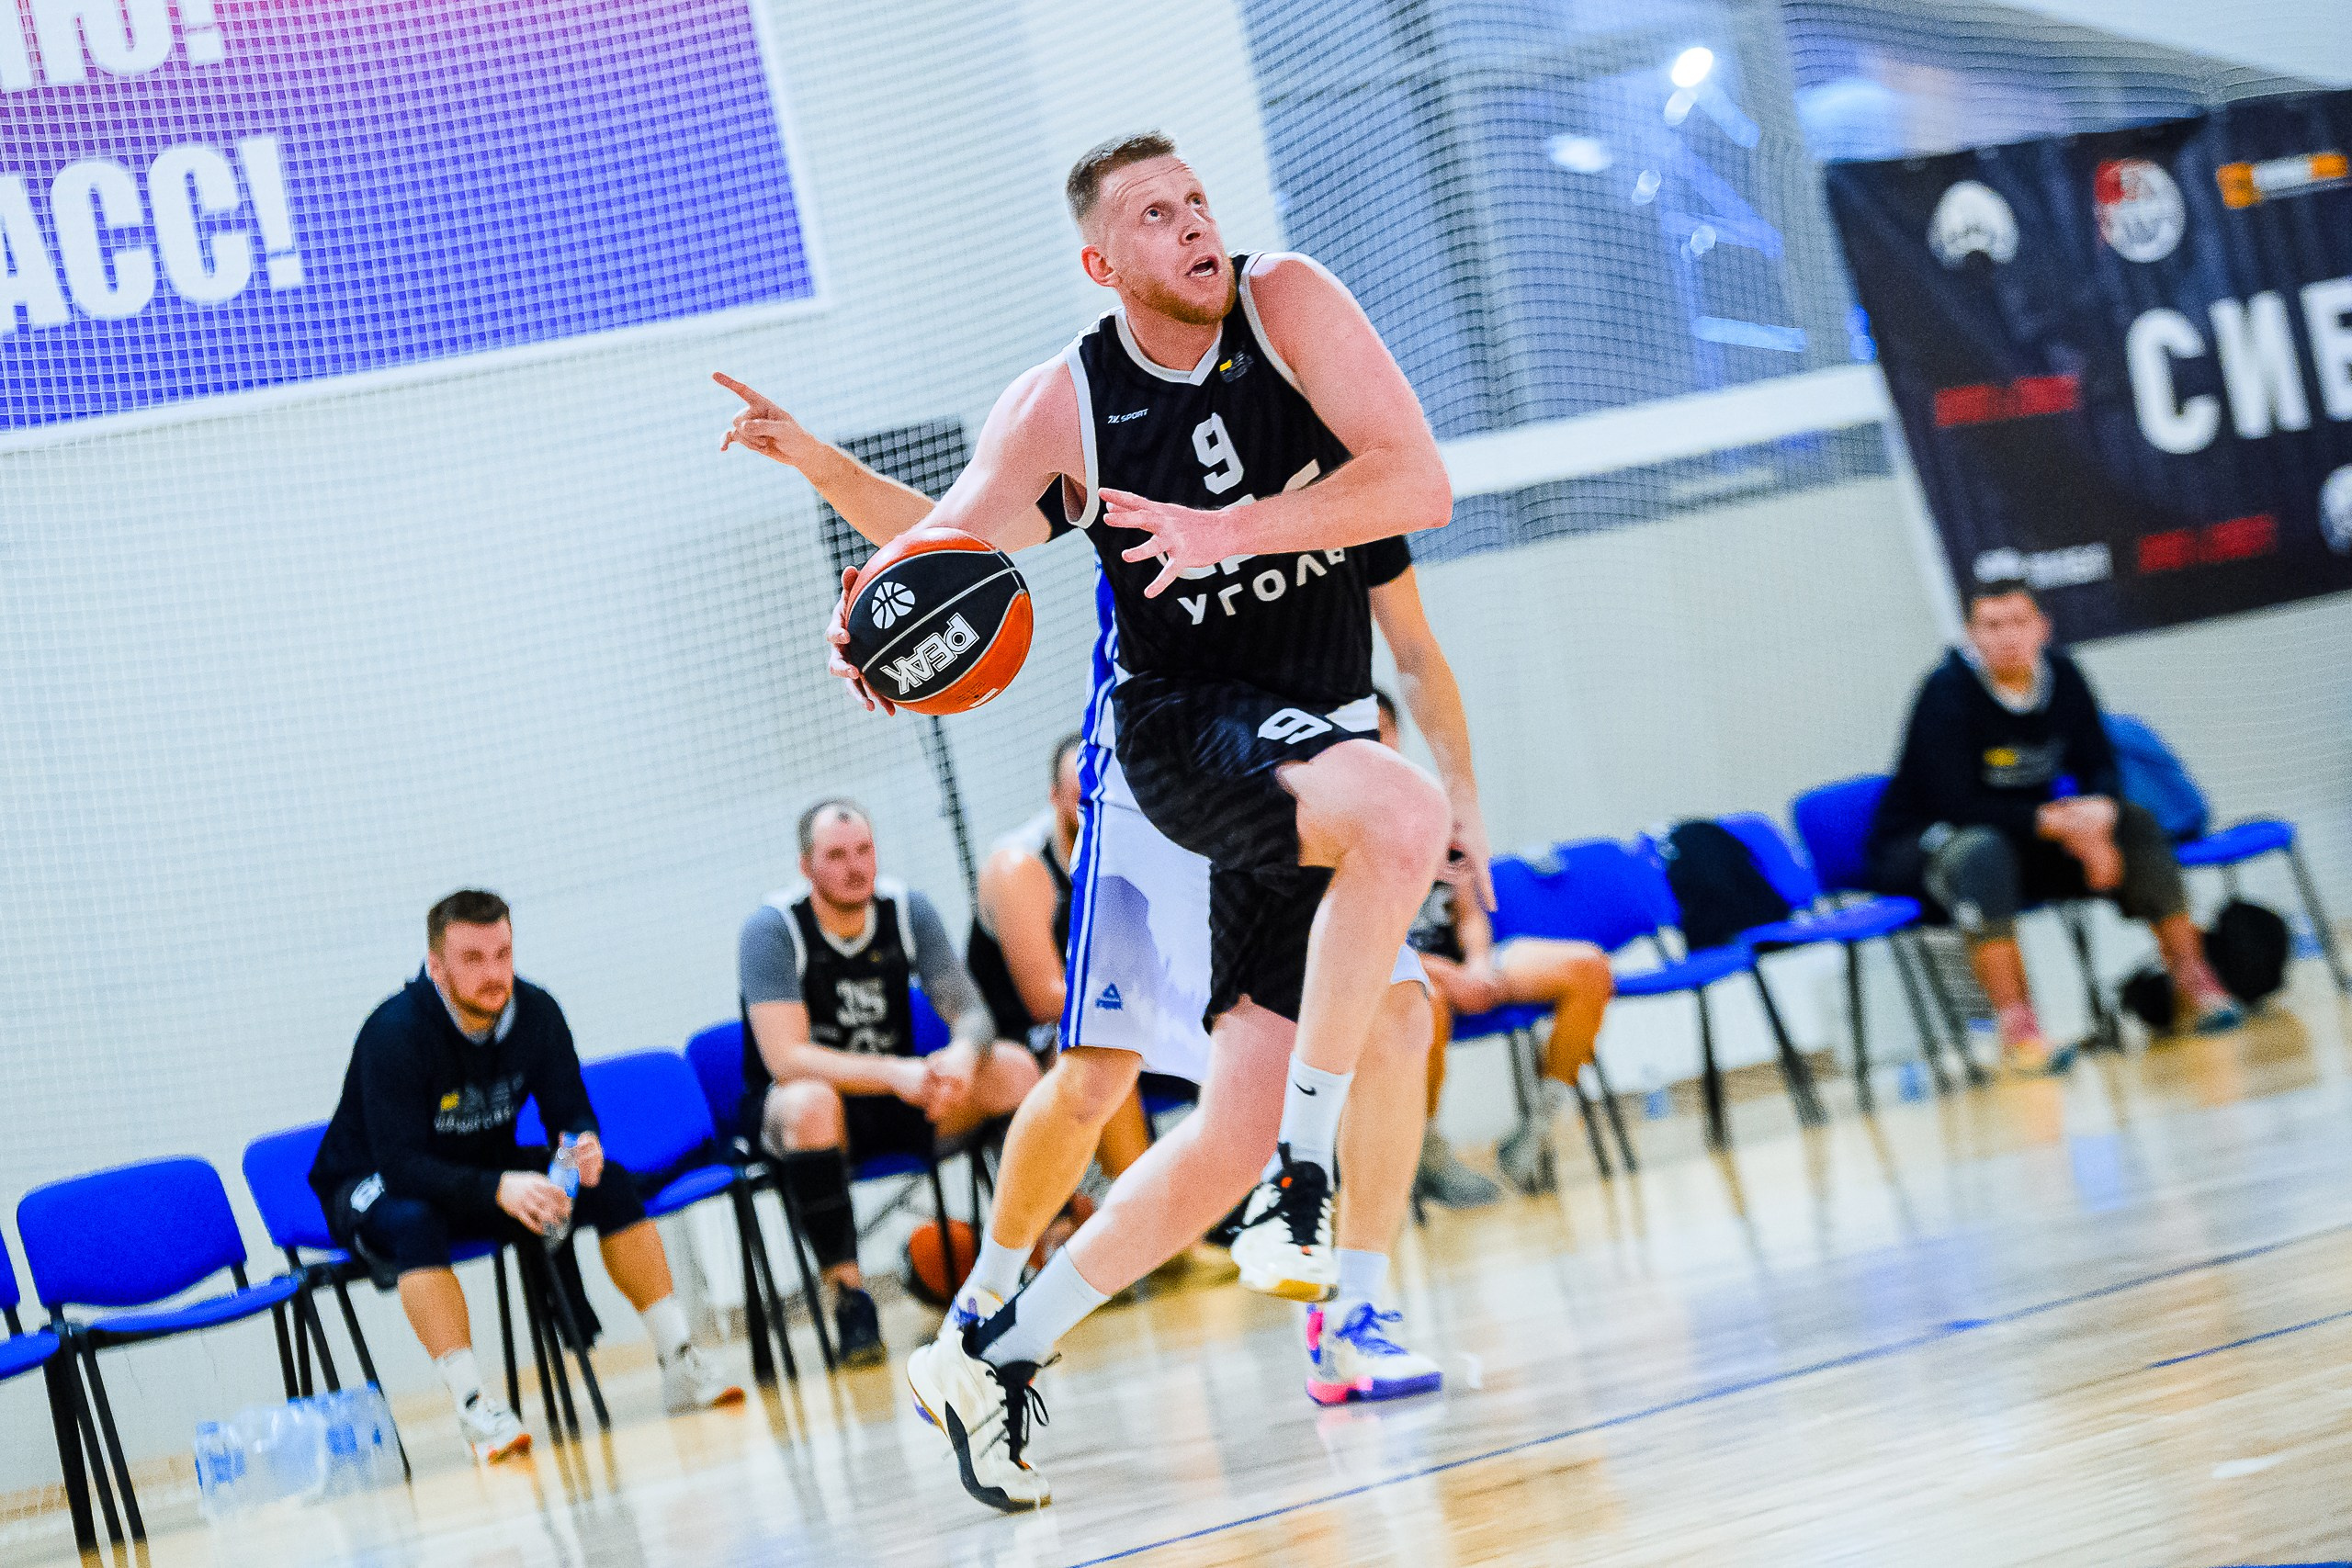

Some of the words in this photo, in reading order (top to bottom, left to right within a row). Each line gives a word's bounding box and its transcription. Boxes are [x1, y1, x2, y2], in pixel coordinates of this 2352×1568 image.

[1121, 408, 1148, 423] SPORT
[1193, 412, 1244, 494] 9
[880, 612, 979, 695] PEAK
[1257, 707, 1333, 745] 9
